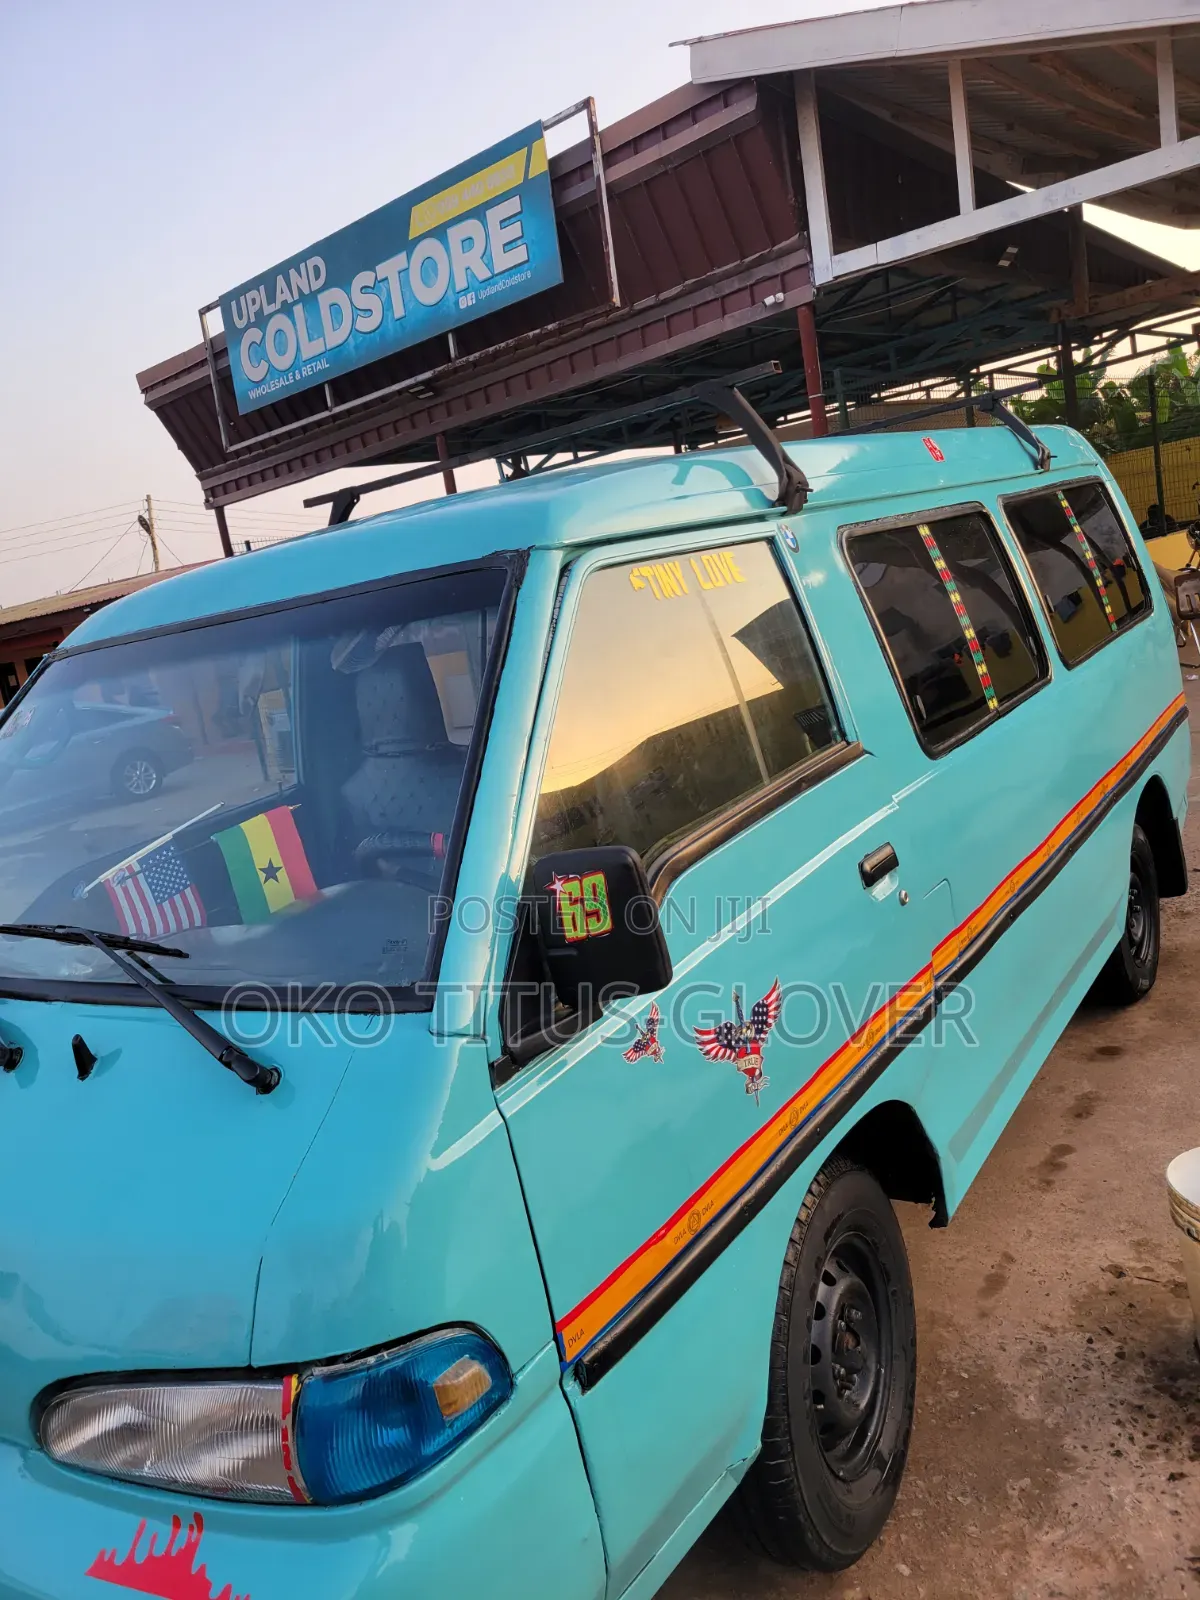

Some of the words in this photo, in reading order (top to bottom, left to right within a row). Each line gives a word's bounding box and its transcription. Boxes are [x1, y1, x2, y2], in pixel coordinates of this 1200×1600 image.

[231, 256, 326, 329] UPLAND
[240, 194, 530, 382] COLDSTORE
[248, 372, 294, 399] WHOLESALE
[295, 370, 301, 380] &
[302, 358, 330, 377] RETAIL
[689, 551, 746, 590] LOVE
[568, 1328, 585, 1348] DVLA
